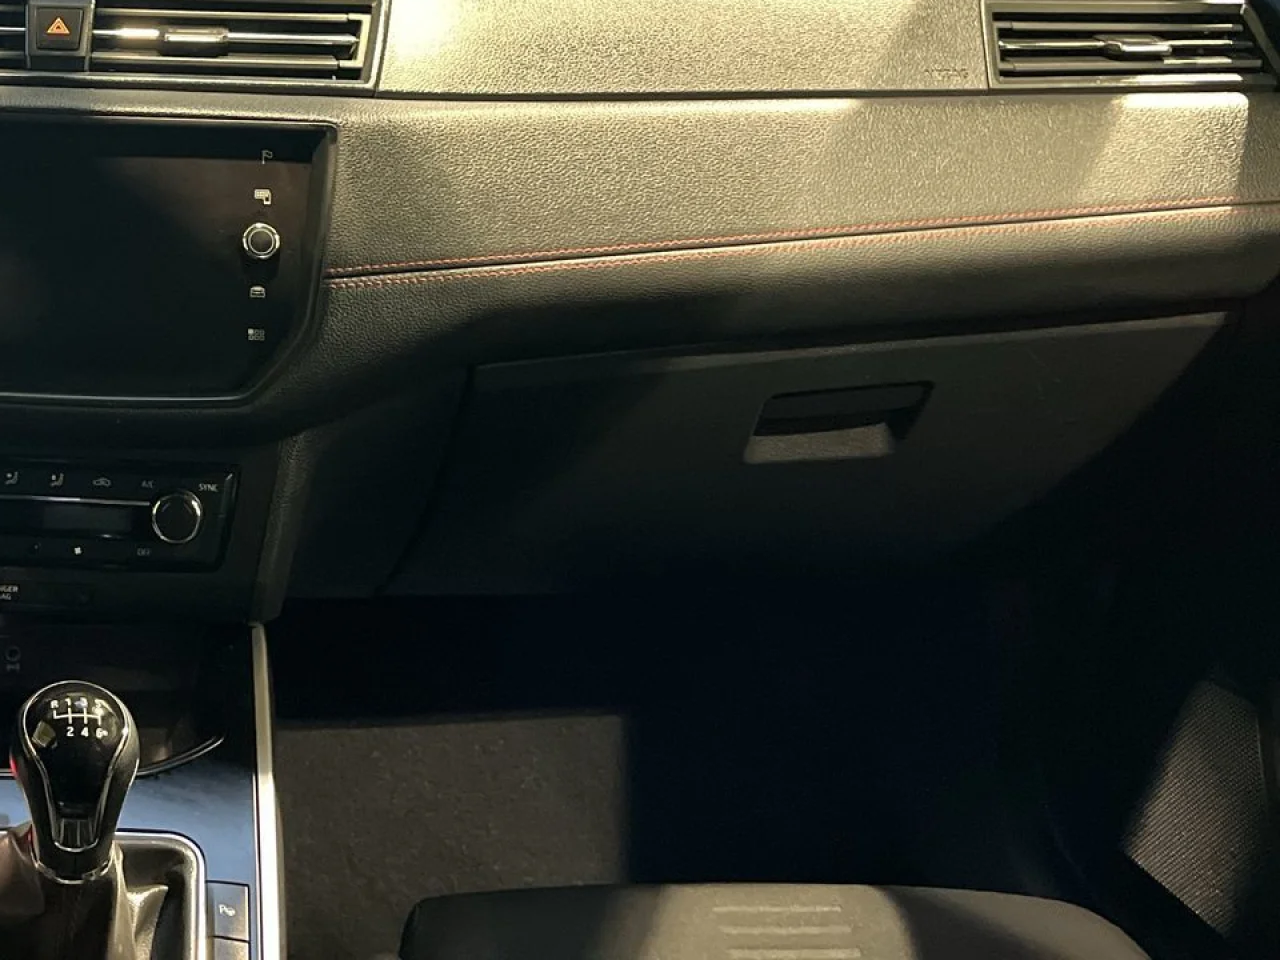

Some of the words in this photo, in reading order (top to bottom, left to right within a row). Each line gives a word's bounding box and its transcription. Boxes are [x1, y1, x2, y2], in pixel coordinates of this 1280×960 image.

[198, 483, 219, 492] SYNC
[50, 699, 59, 709] R
[64, 697, 72, 706] 1
[66, 726, 74, 737] 2
[80, 726, 89, 737] 4
